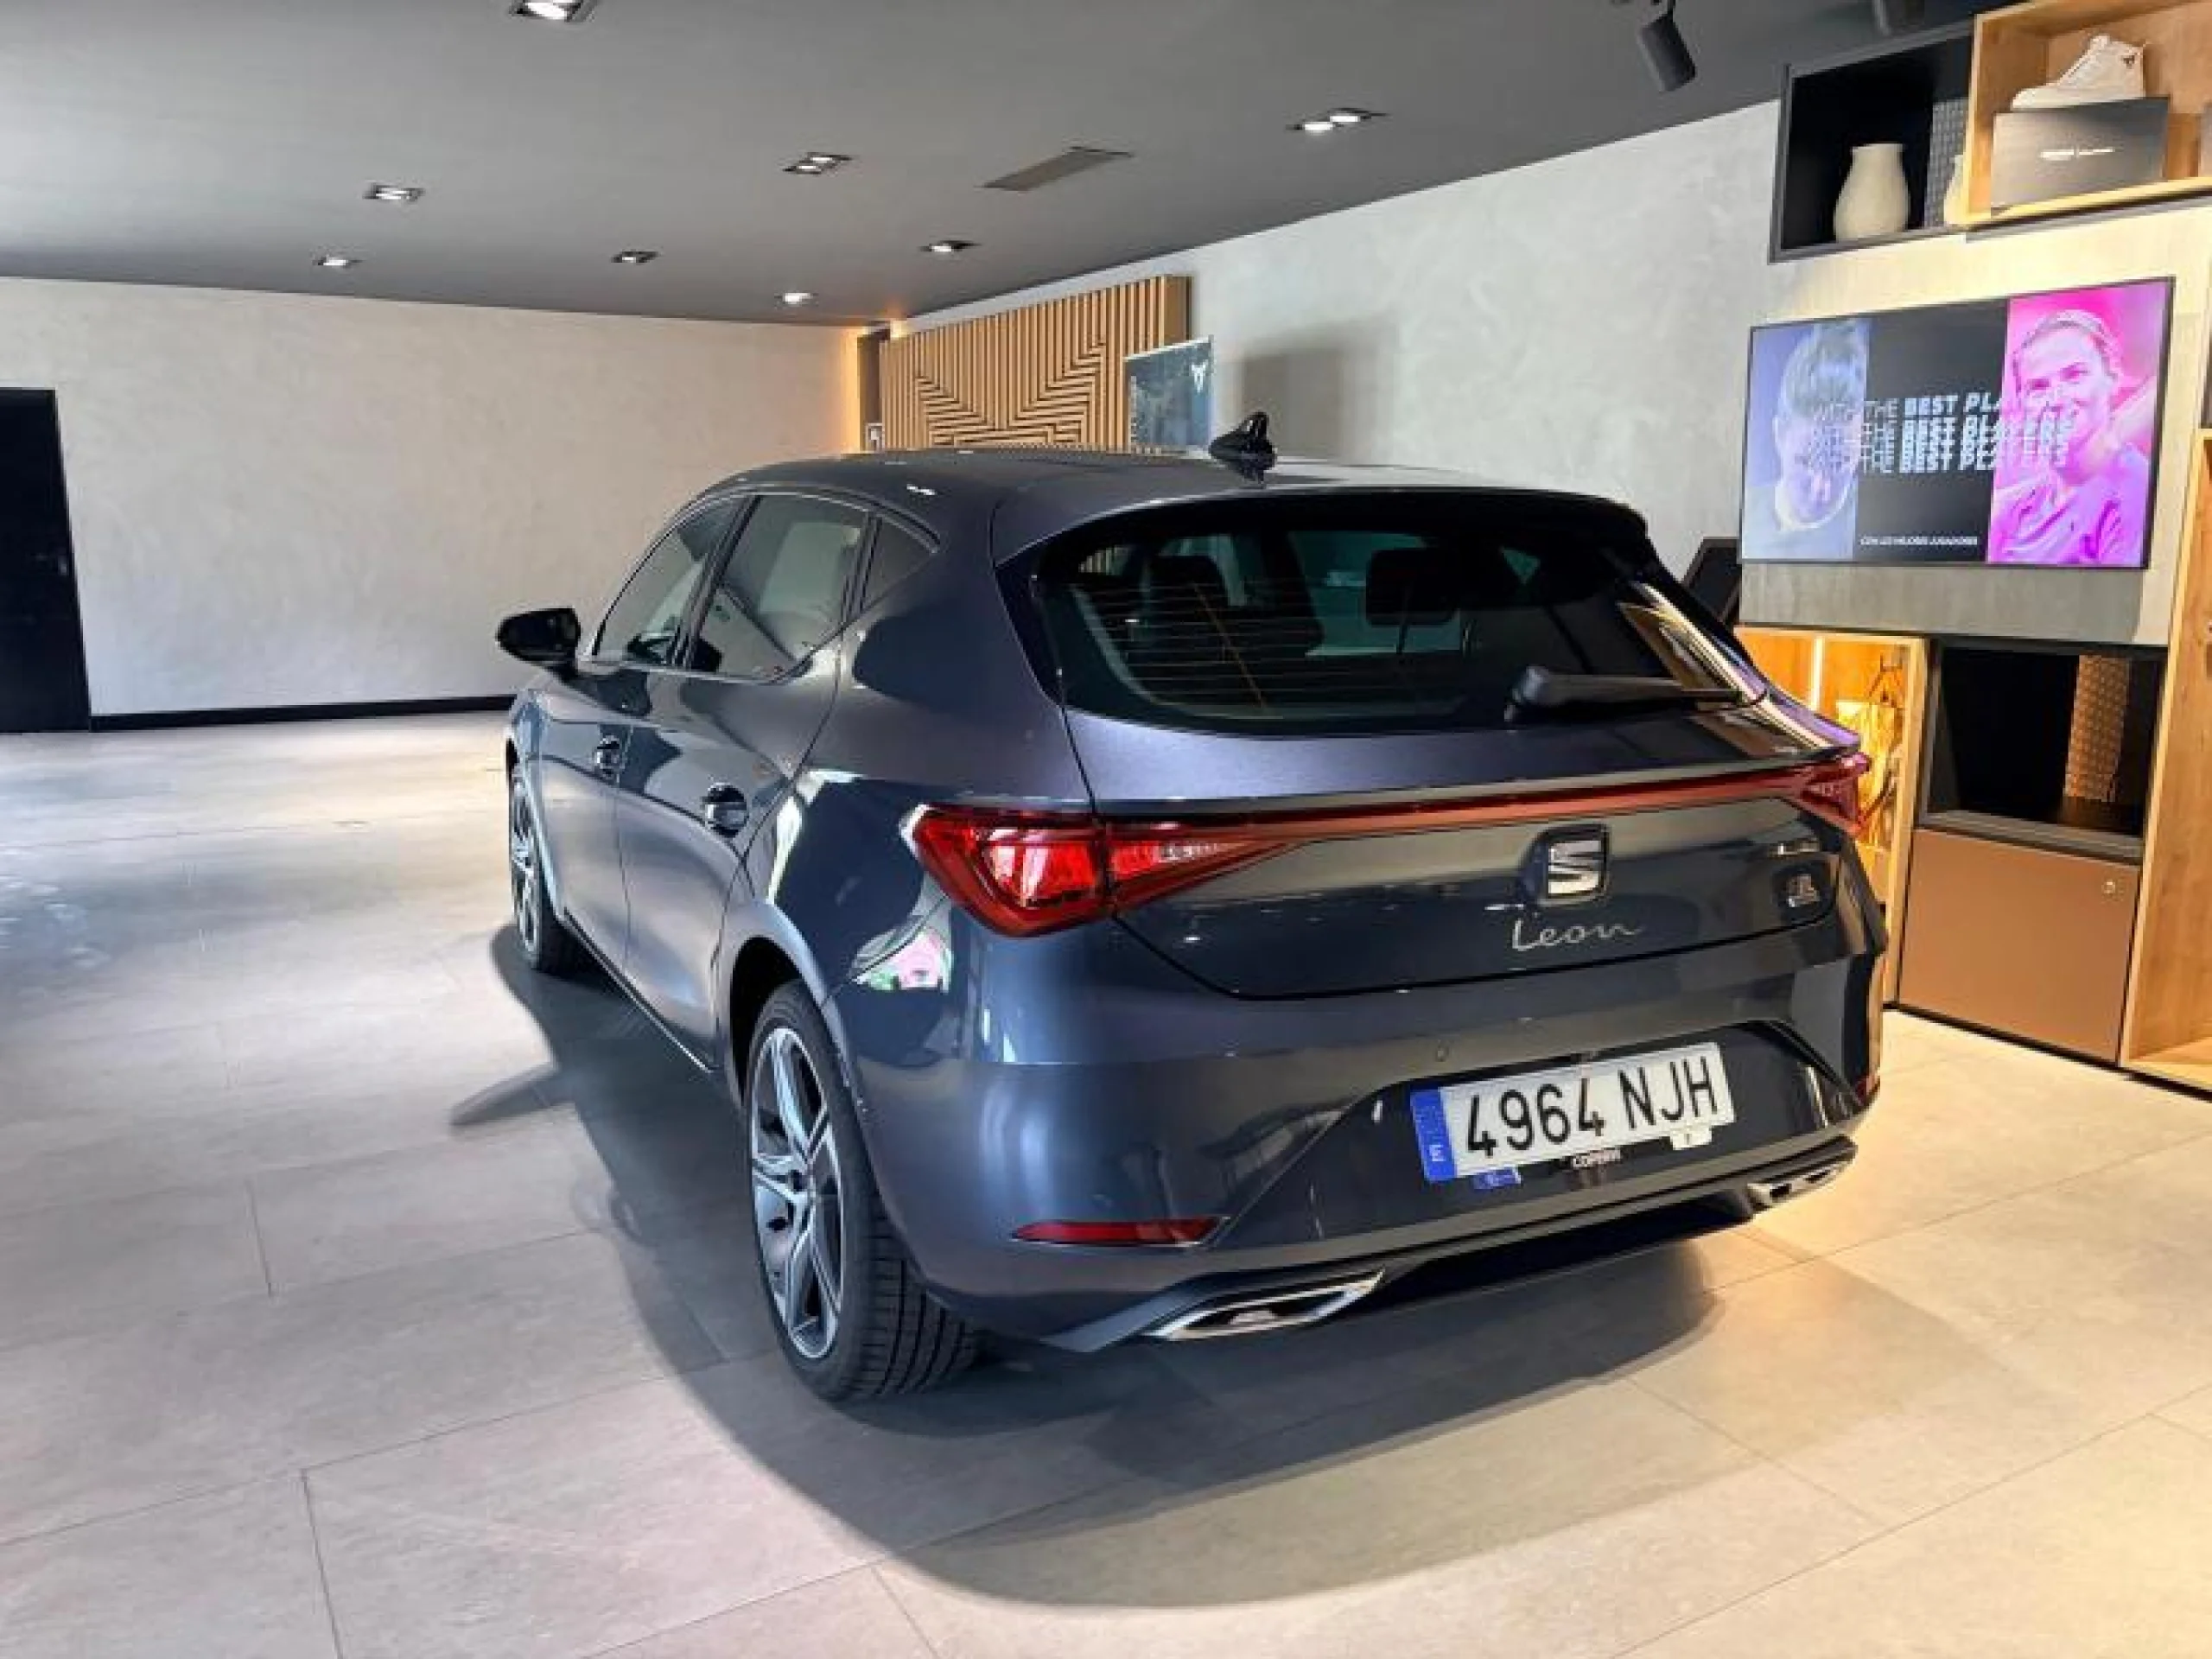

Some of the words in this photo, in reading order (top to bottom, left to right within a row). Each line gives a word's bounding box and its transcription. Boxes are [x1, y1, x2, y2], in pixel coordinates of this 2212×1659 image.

[1904, 395, 1959, 416] BEST
[1511, 917, 1643, 952] Leon
[1467, 1077, 1605, 1158] 4964
[1618, 1055, 1719, 1130] NJH
[1428, 1143, 1446, 1163] E
